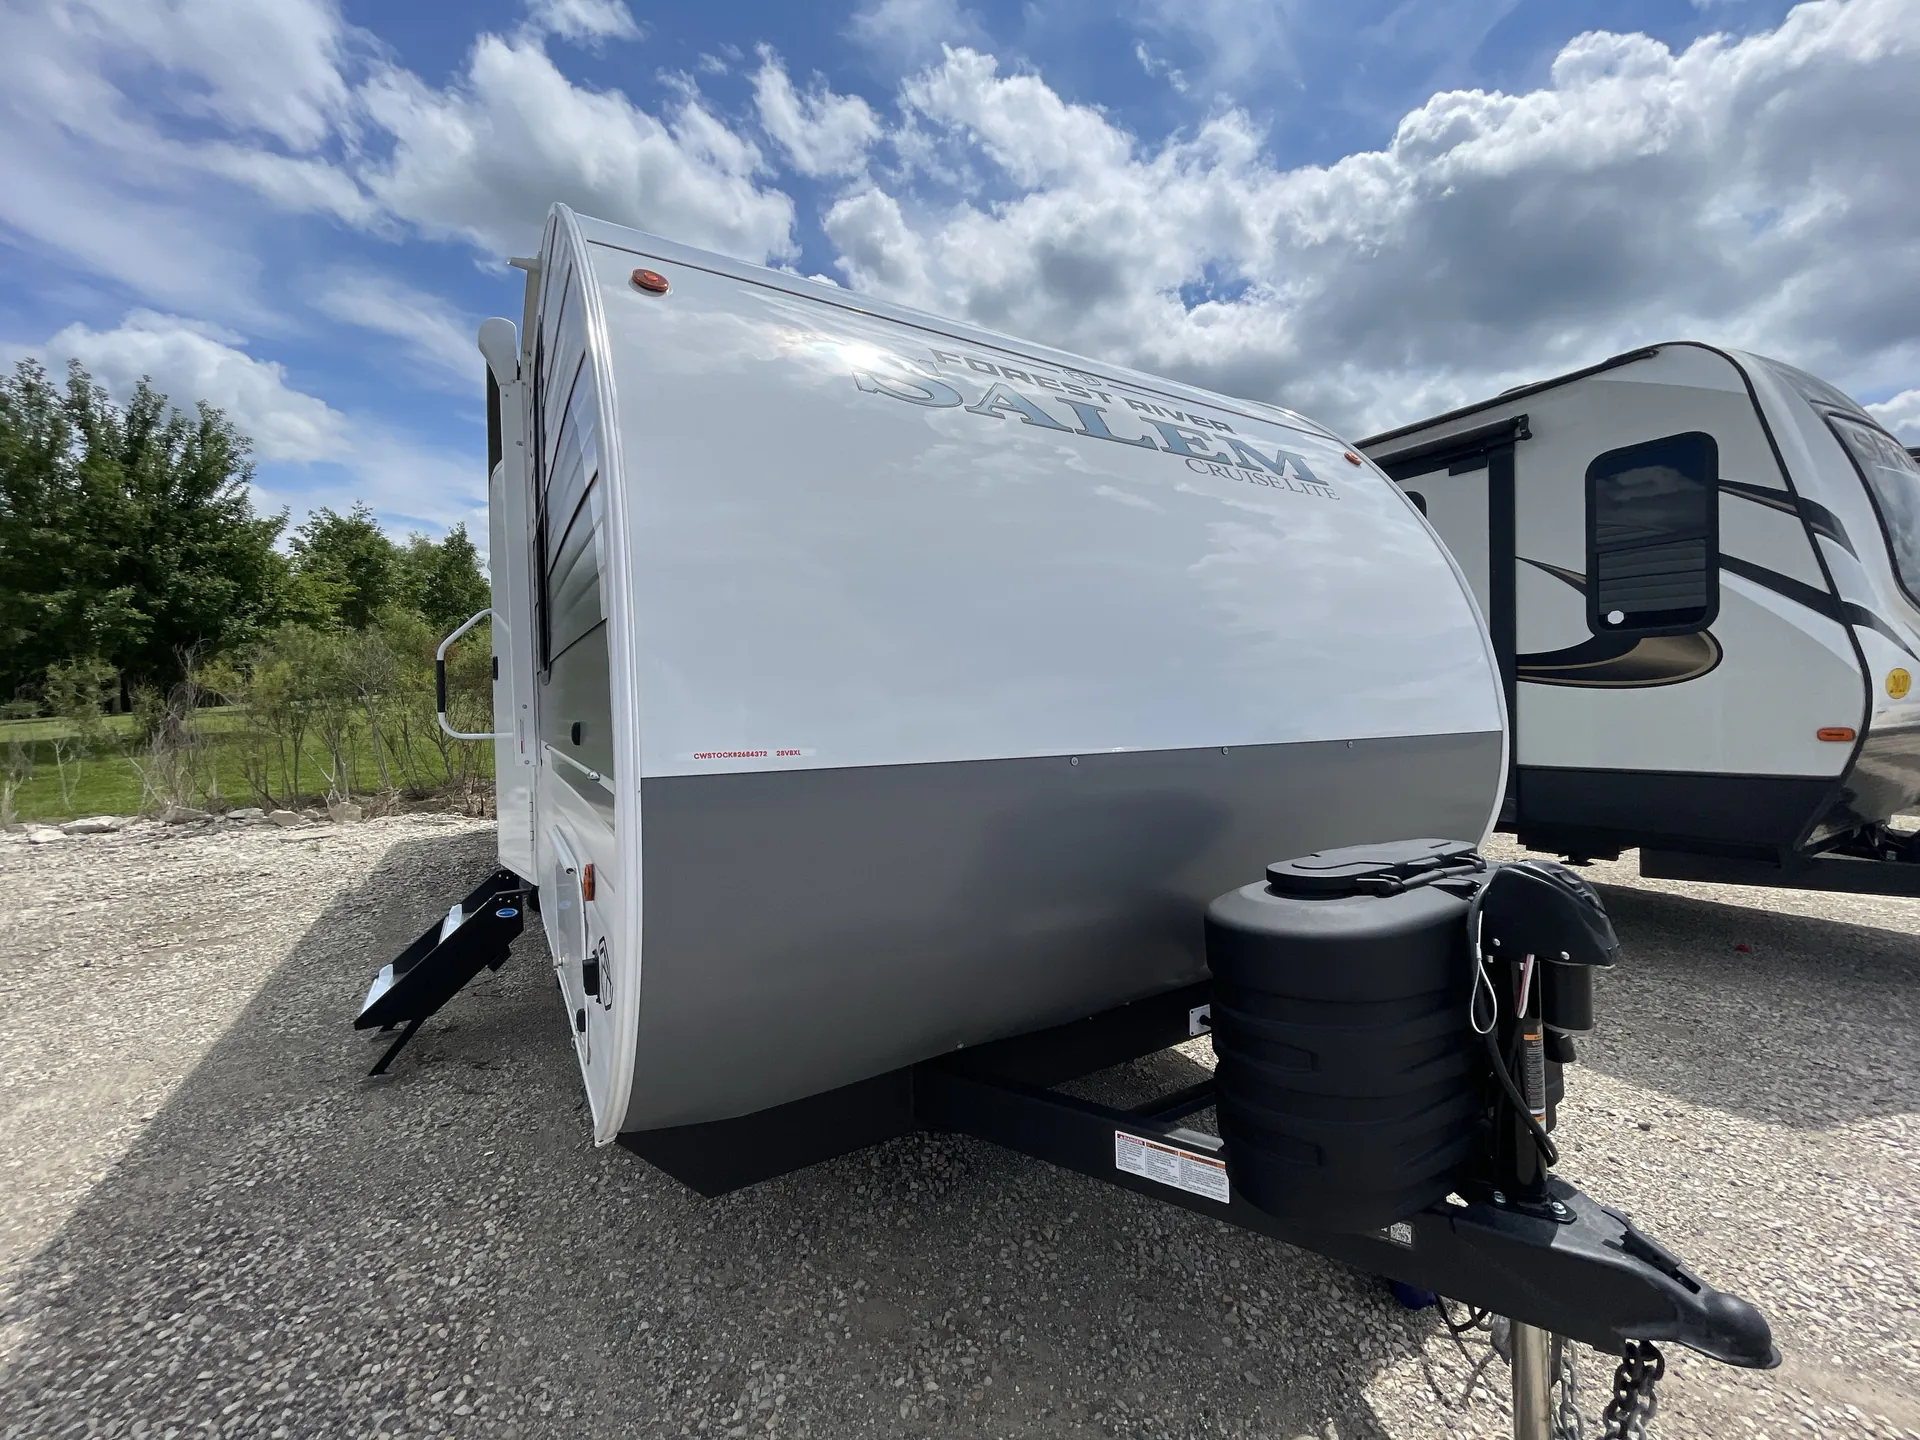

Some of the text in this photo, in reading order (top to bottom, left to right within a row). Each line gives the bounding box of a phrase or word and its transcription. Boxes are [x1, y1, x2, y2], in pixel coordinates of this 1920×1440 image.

[852, 356, 1329, 486] SALEM
[928, 348, 1237, 435] FOREST RIVER
